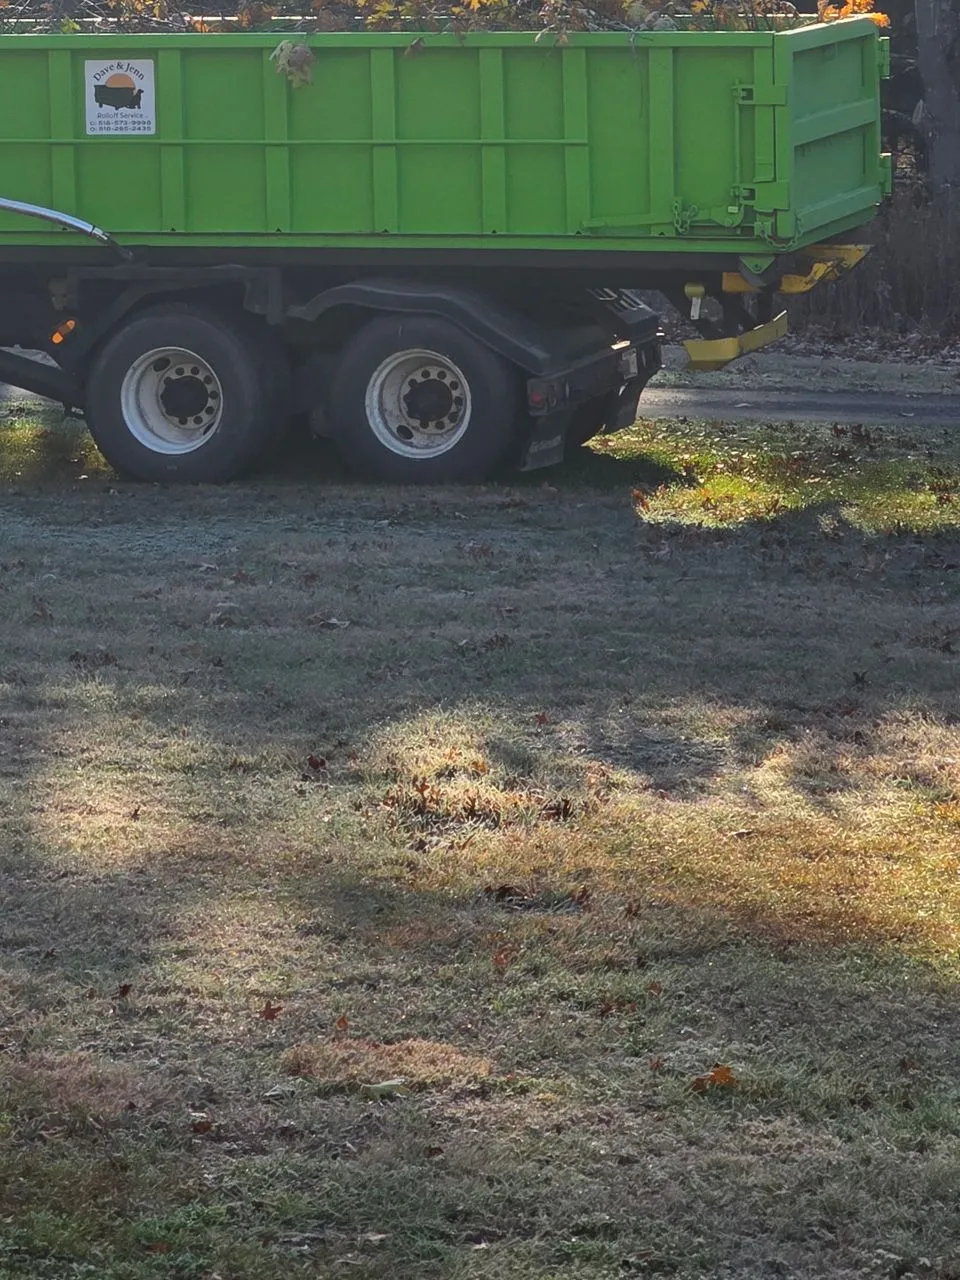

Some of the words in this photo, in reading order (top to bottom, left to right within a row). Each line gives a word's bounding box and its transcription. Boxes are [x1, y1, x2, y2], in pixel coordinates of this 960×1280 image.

[93, 65, 115, 81] Dave
[116, 62, 124, 70] &
[125, 63, 145, 80] Jenn
